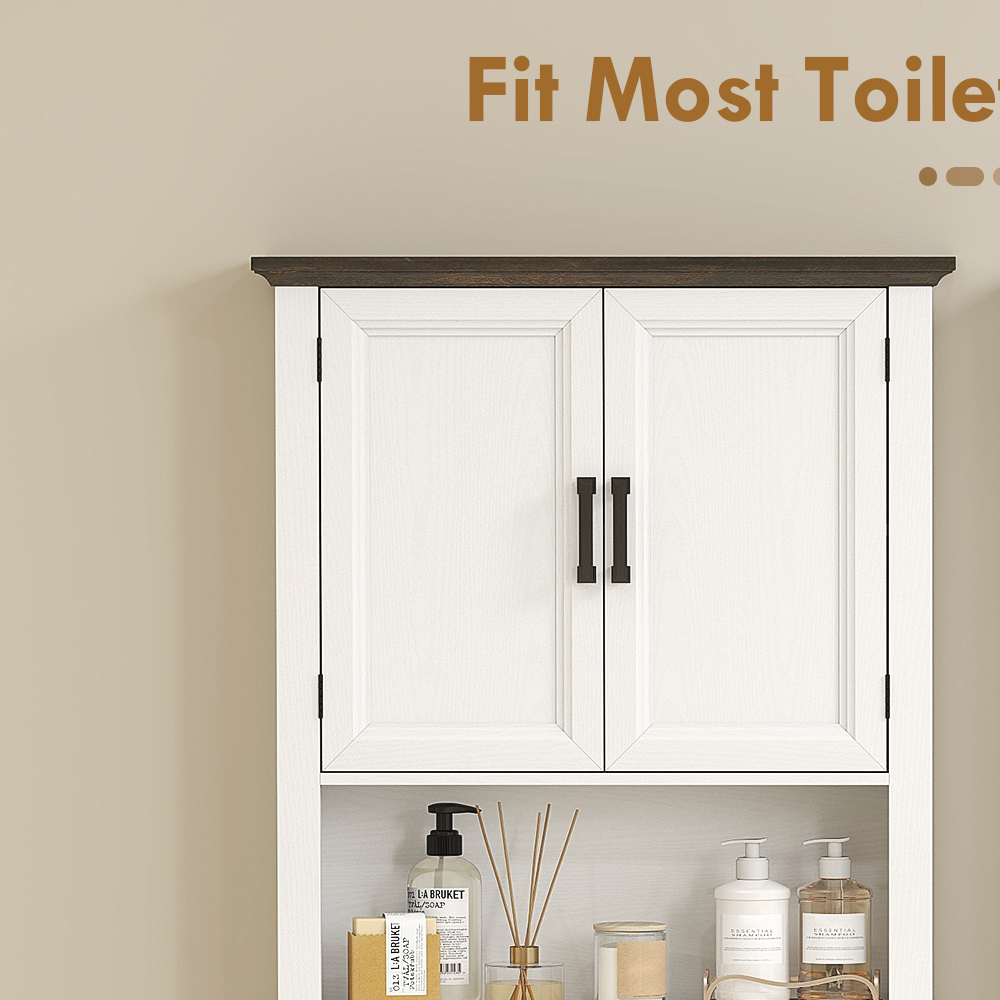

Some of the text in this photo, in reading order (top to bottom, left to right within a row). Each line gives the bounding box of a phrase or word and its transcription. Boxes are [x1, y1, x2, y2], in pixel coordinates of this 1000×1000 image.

[417, 889, 428, 899] L:A
[430, 889, 465, 899] BRUKET
[390, 956, 400, 970] L:A
